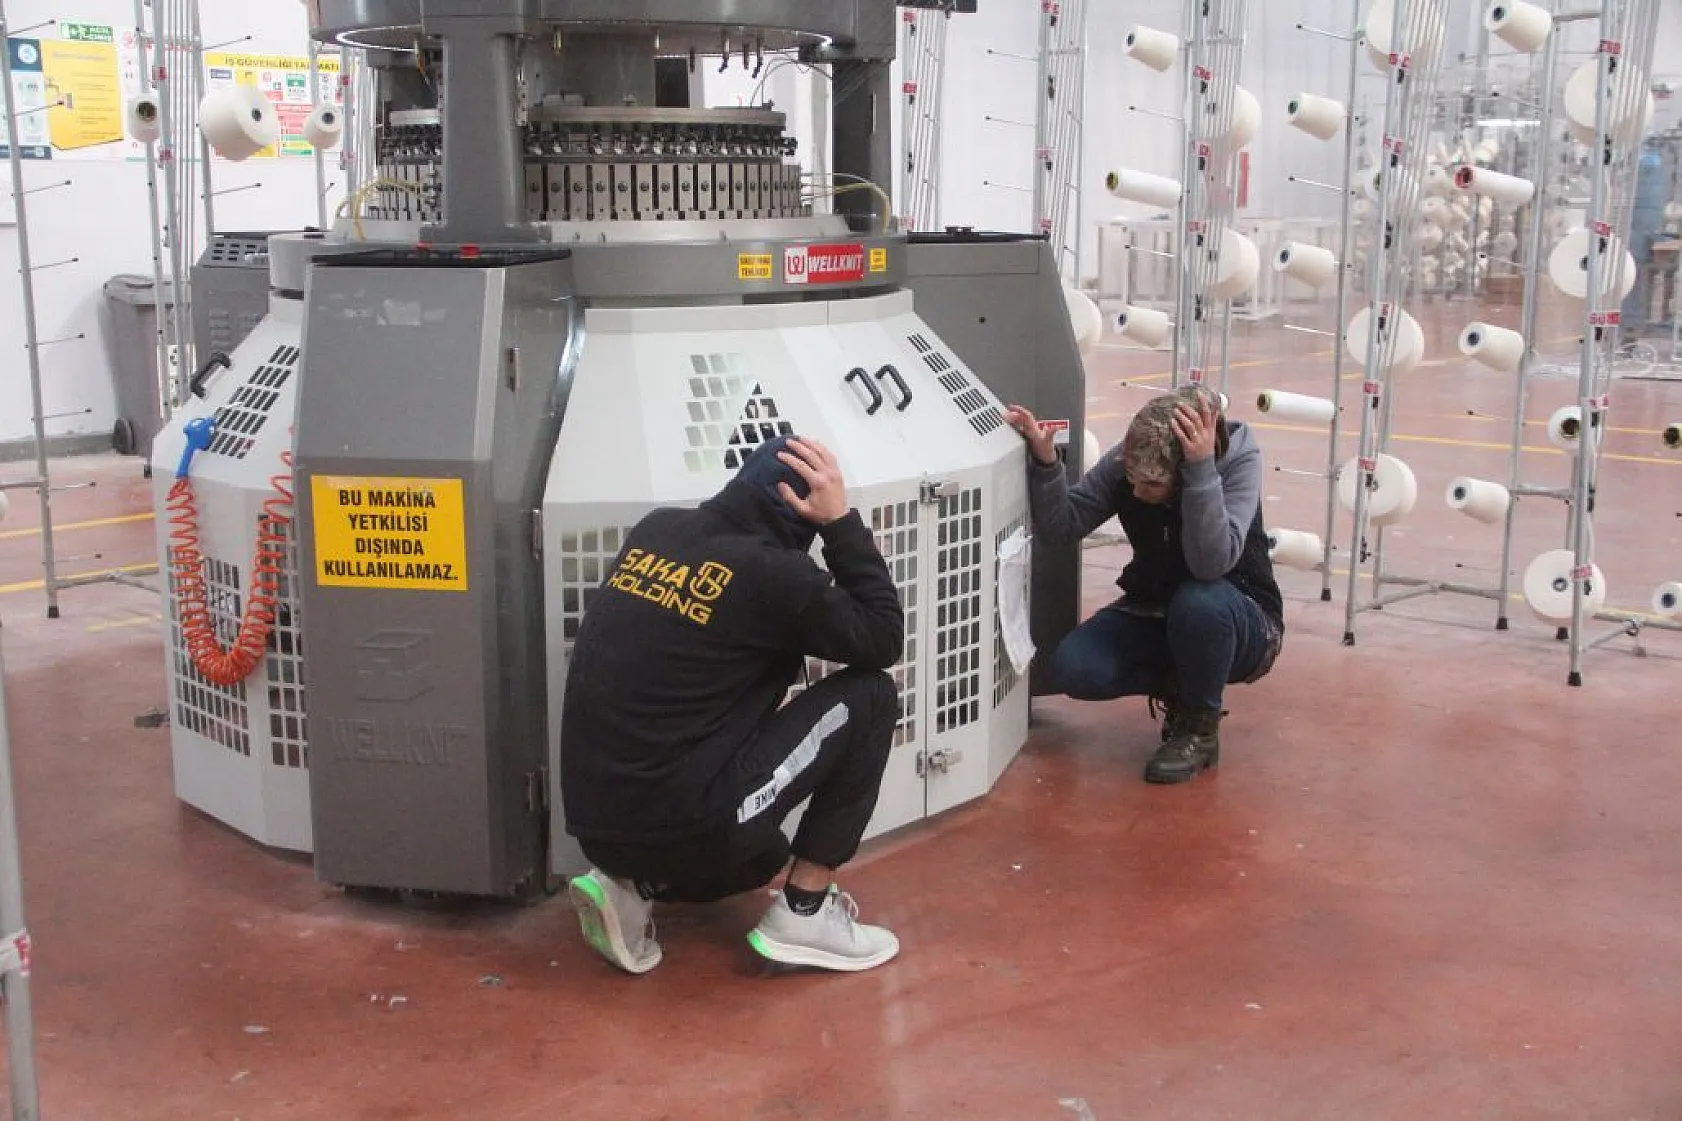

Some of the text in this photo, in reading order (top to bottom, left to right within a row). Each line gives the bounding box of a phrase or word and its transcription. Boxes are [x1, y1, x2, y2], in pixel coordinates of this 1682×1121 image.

[808, 253, 863, 274] WELLKNIT
[339, 487, 436, 508] BU MAKİNA
[348, 509, 428, 532] YETKİLİSİ
[355, 537, 424, 558] DIŞINDA
[324, 560, 458, 581] KULLANILAMAZ.
[620, 548, 690, 589] SAKA
